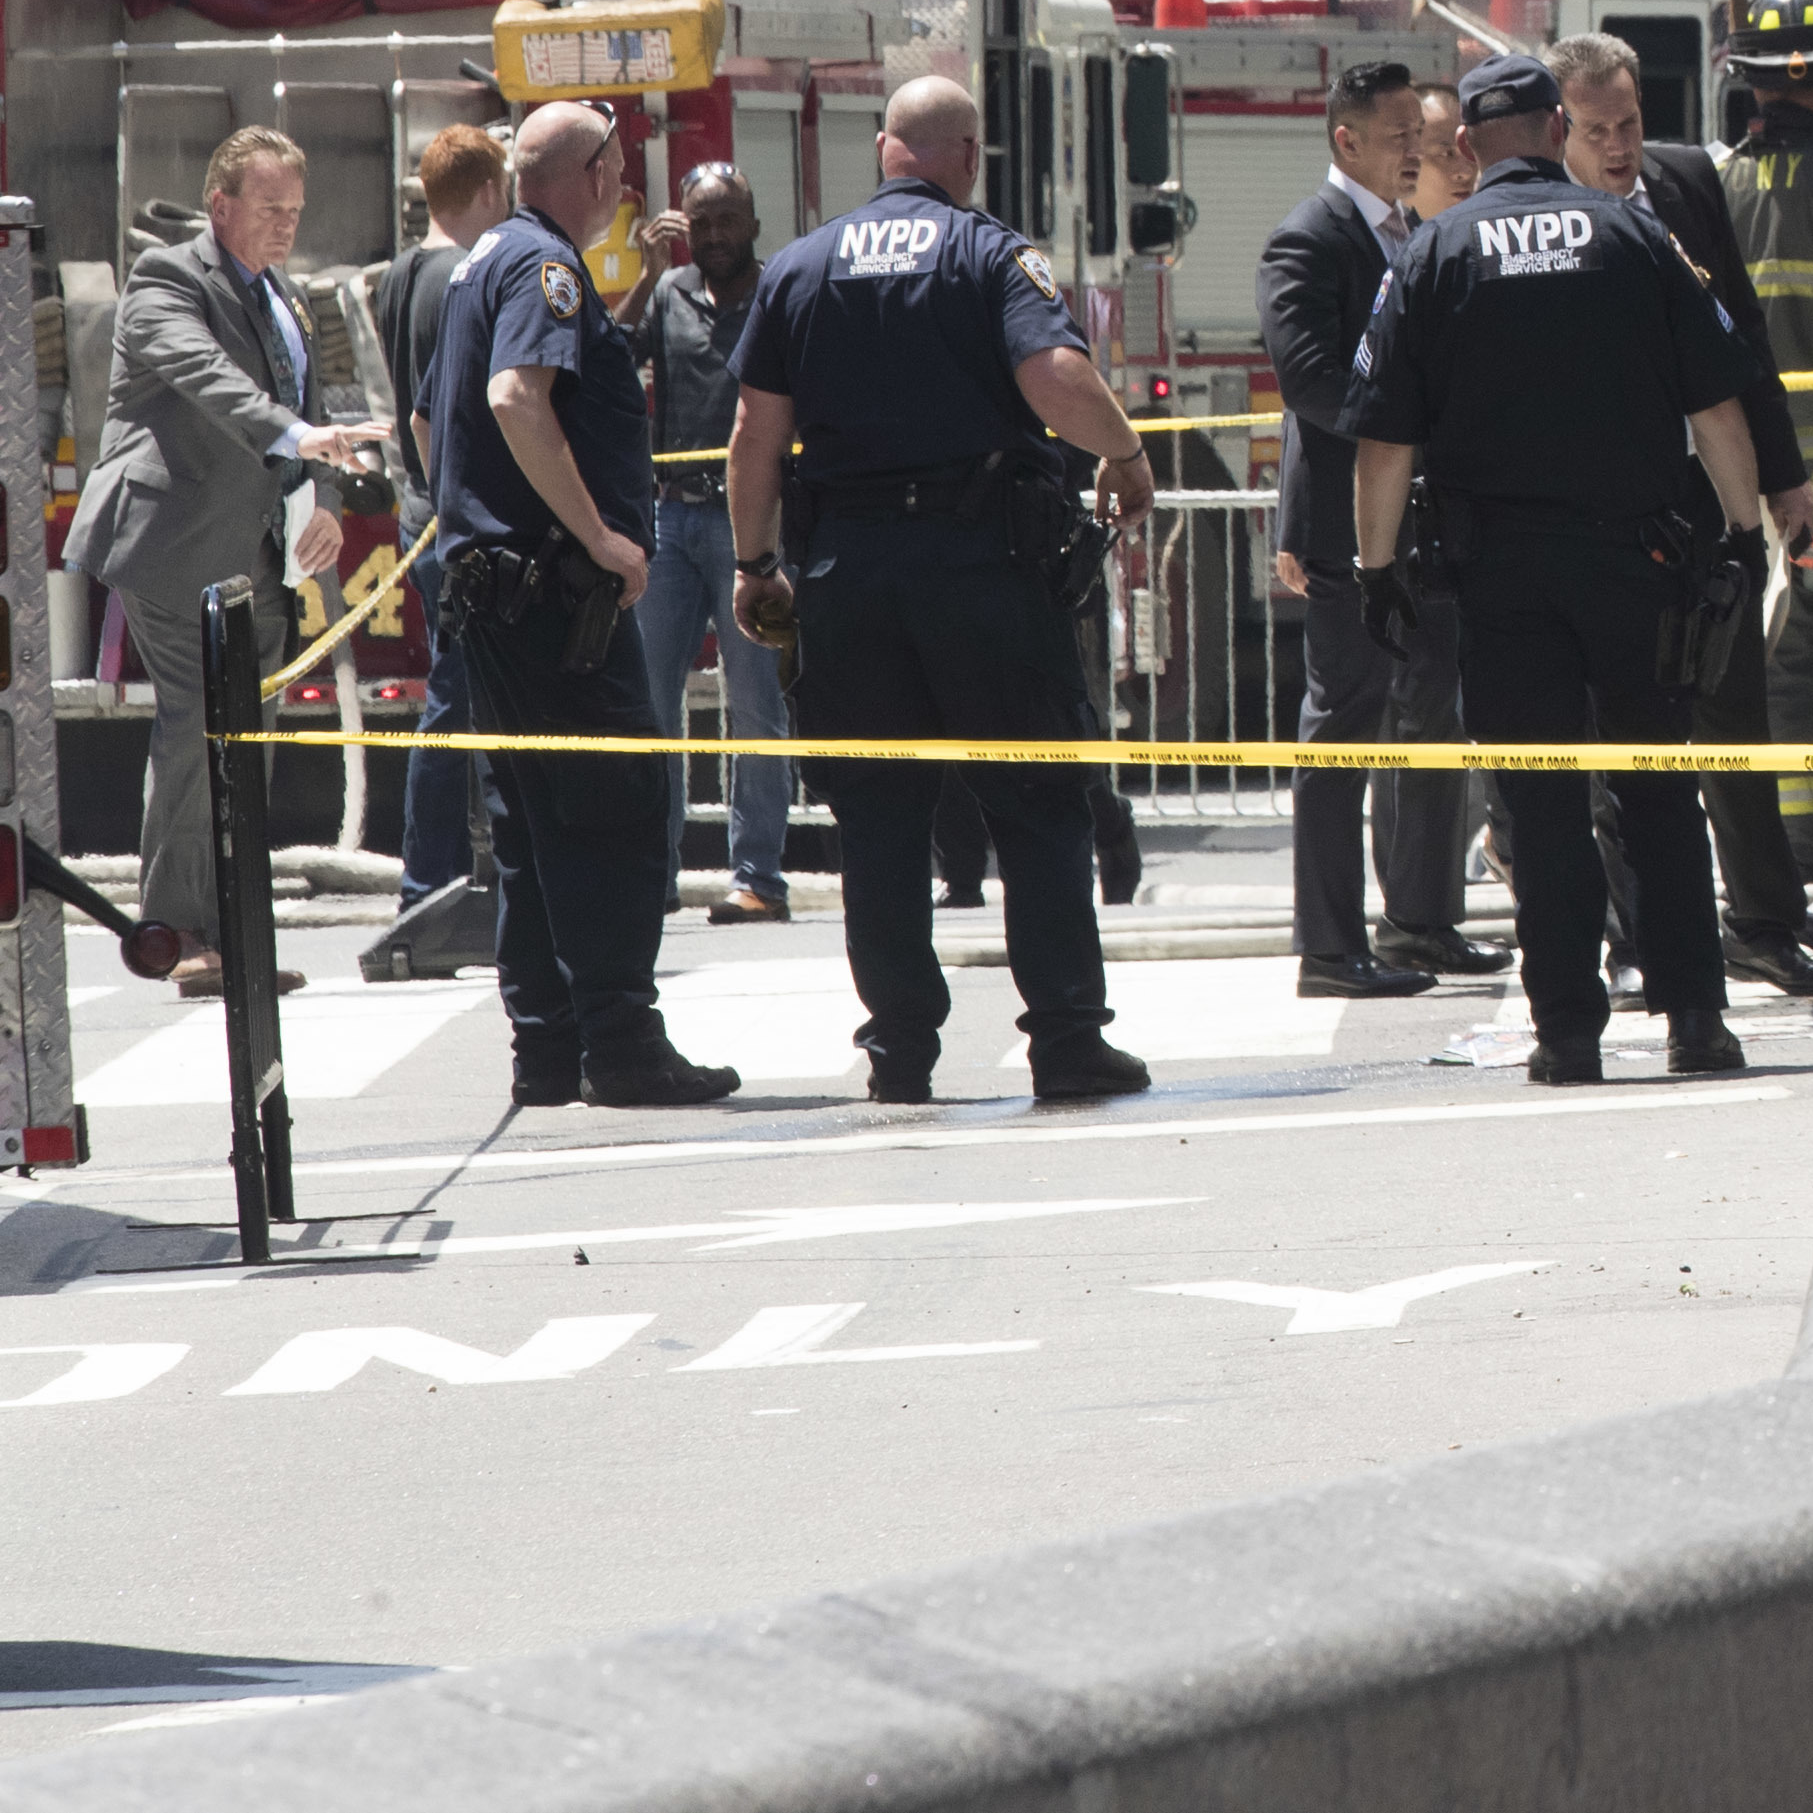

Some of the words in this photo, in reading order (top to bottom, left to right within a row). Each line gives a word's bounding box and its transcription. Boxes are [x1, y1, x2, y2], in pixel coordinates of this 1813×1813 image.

[838, 219, 938, 258] NYPD
[1477, 210, 1593, 257] NYPD
[854, 252, 914, 266] EMERGENCY
[1500, 248, 1575, 265] EMERGENCY
[849, 261, 891, 275] SERVICE
[893, 259, 918, 273] UNIT
[1499, 258, 1551, 276] SERVICE
[1553, 256, 1582, 271] UNIT
